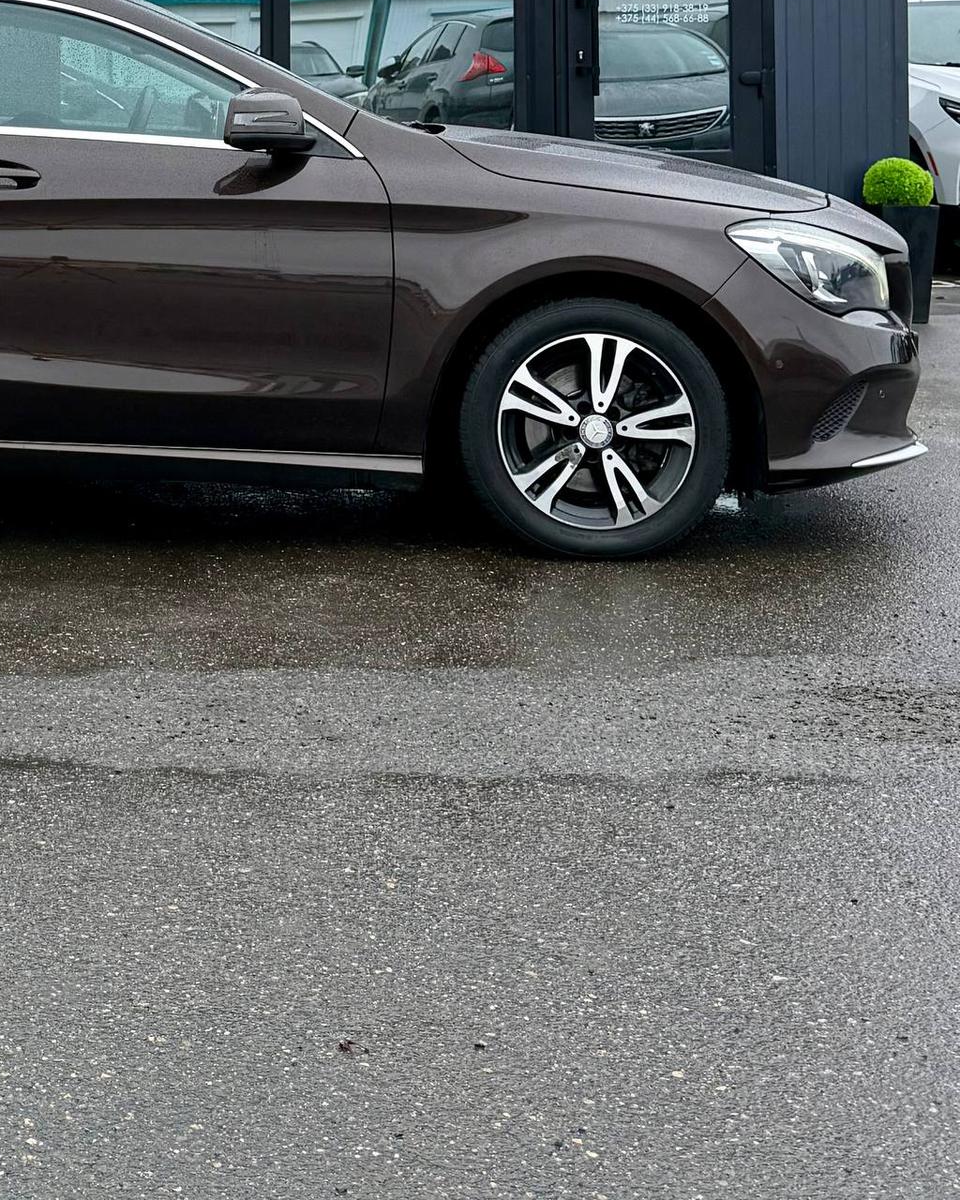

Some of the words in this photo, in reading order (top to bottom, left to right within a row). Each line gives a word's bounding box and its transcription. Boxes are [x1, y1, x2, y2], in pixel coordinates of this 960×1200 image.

[615, 4, 640, 13] +375
[615, 14, 640, 23] +375
[641, 14, 660, 25] (44)
[662, 14, 709, 23] 568-66-88
